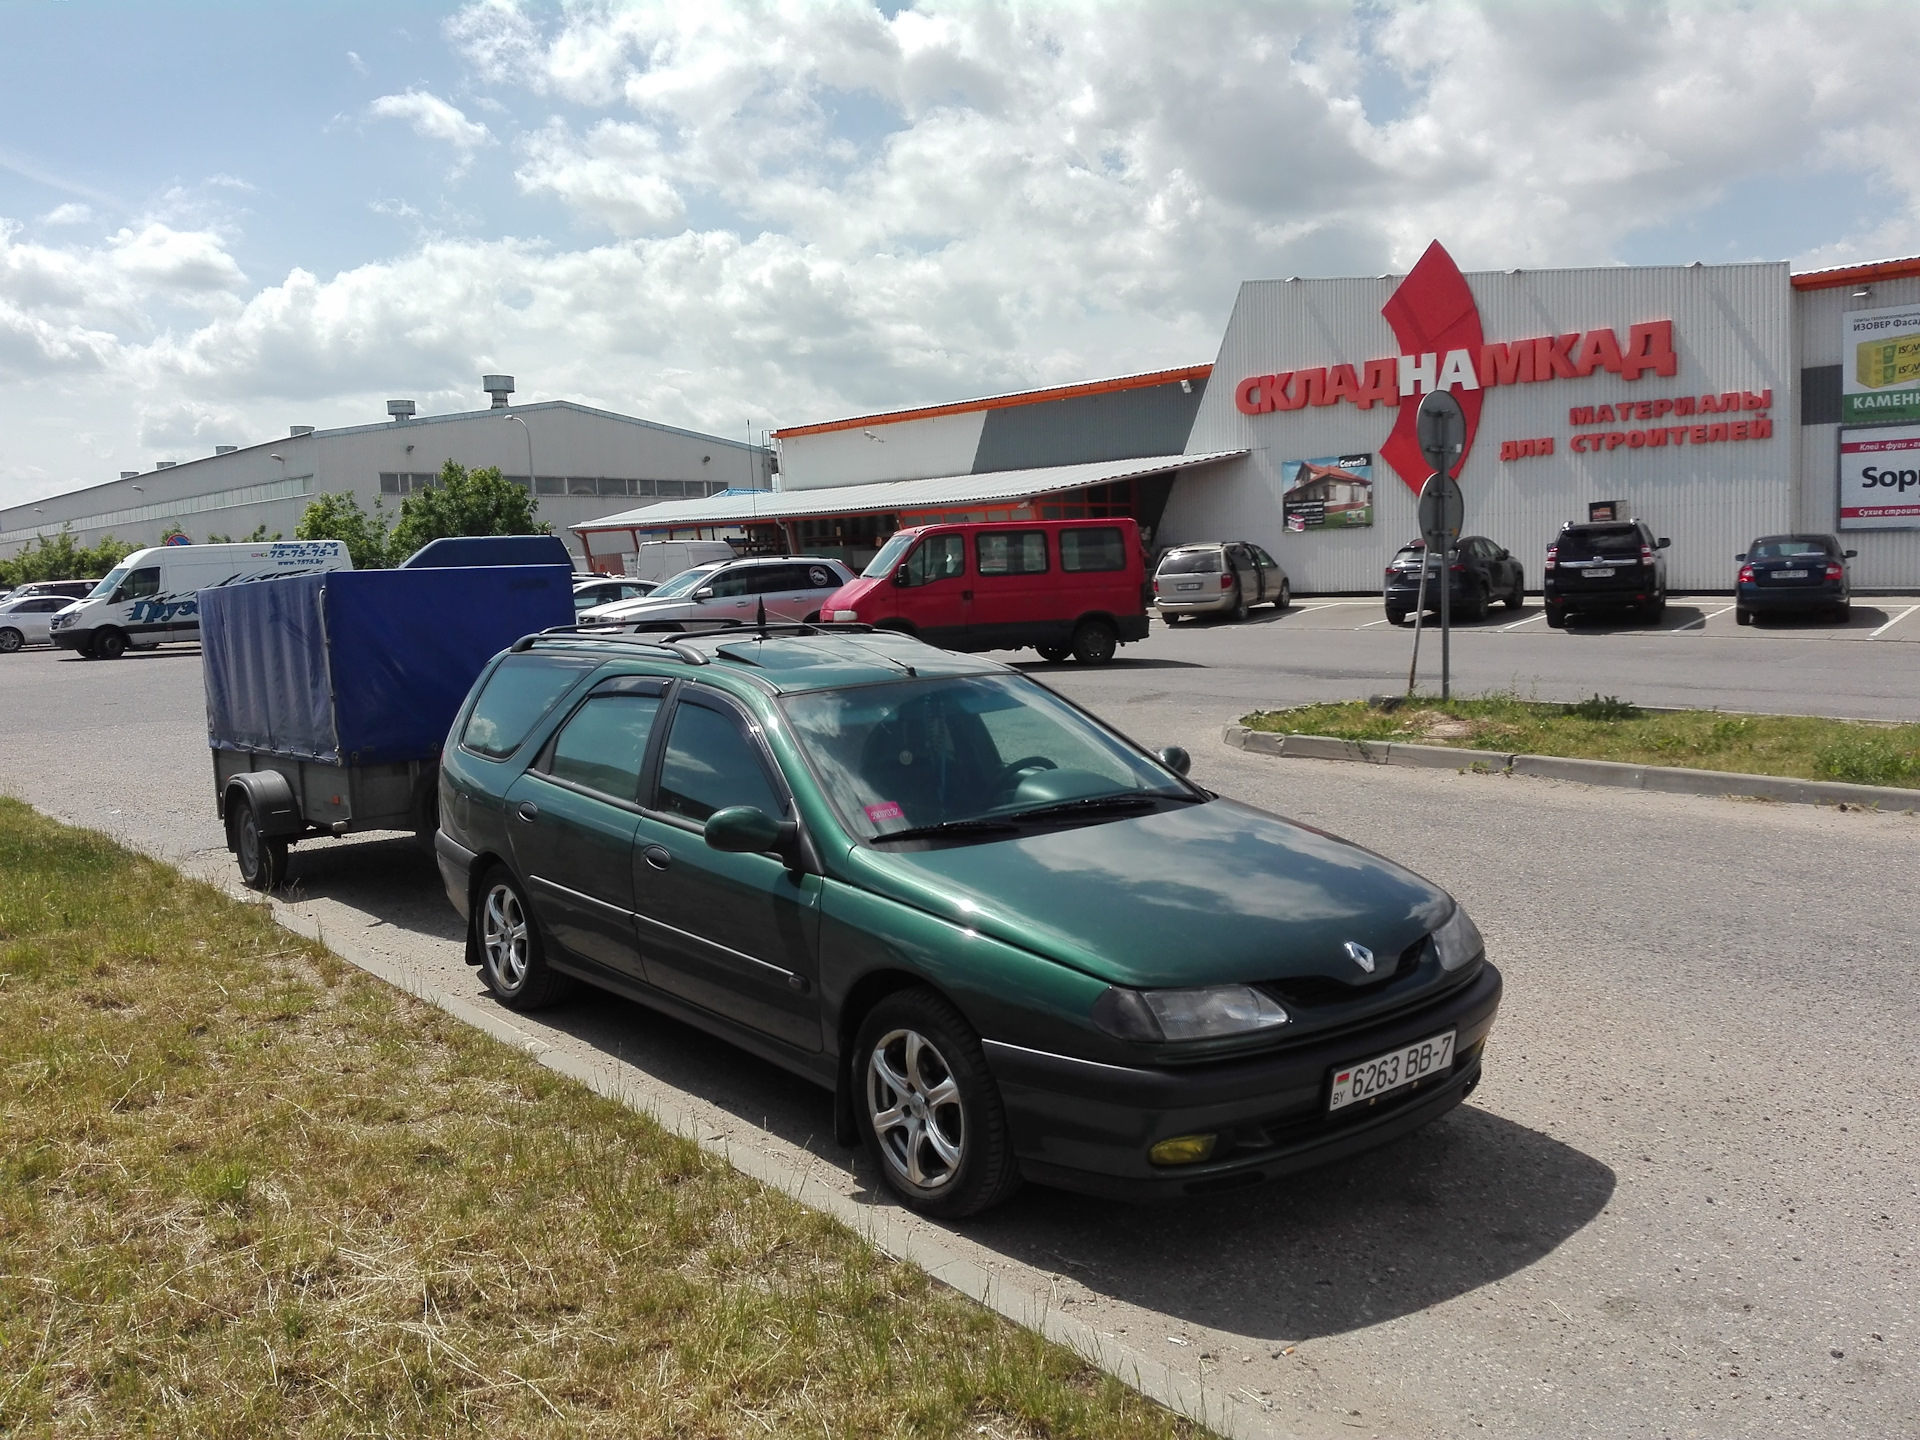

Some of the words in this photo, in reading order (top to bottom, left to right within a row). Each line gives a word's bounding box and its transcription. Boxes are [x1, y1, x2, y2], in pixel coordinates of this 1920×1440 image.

[1853, 320, 1891, 332] ИЗОВЕР
[1569, 389, 1772, 425] МАТЕРИАЛЫ
[1500, 437, 1554, 462] ДЛЯ
[1570, 412, 1773, 452] СТРОИТЕЛЕЙ
[1339, 457, 1367, 468] Ceresit
[1862, 466, 1920, 492] Sop
[1858, 508, 1883, 517] Сухие
[269, 549, 339, 559] 75-75-75-1
[128, 600, 199, 624] Груз
[870, 807, 898, 820] 2017
[1352, 1055, 1400, 1098] 6263
[1405, 1035, 1452, 1080] BB-7
[1332, 1090, 1345, 1105] BY
